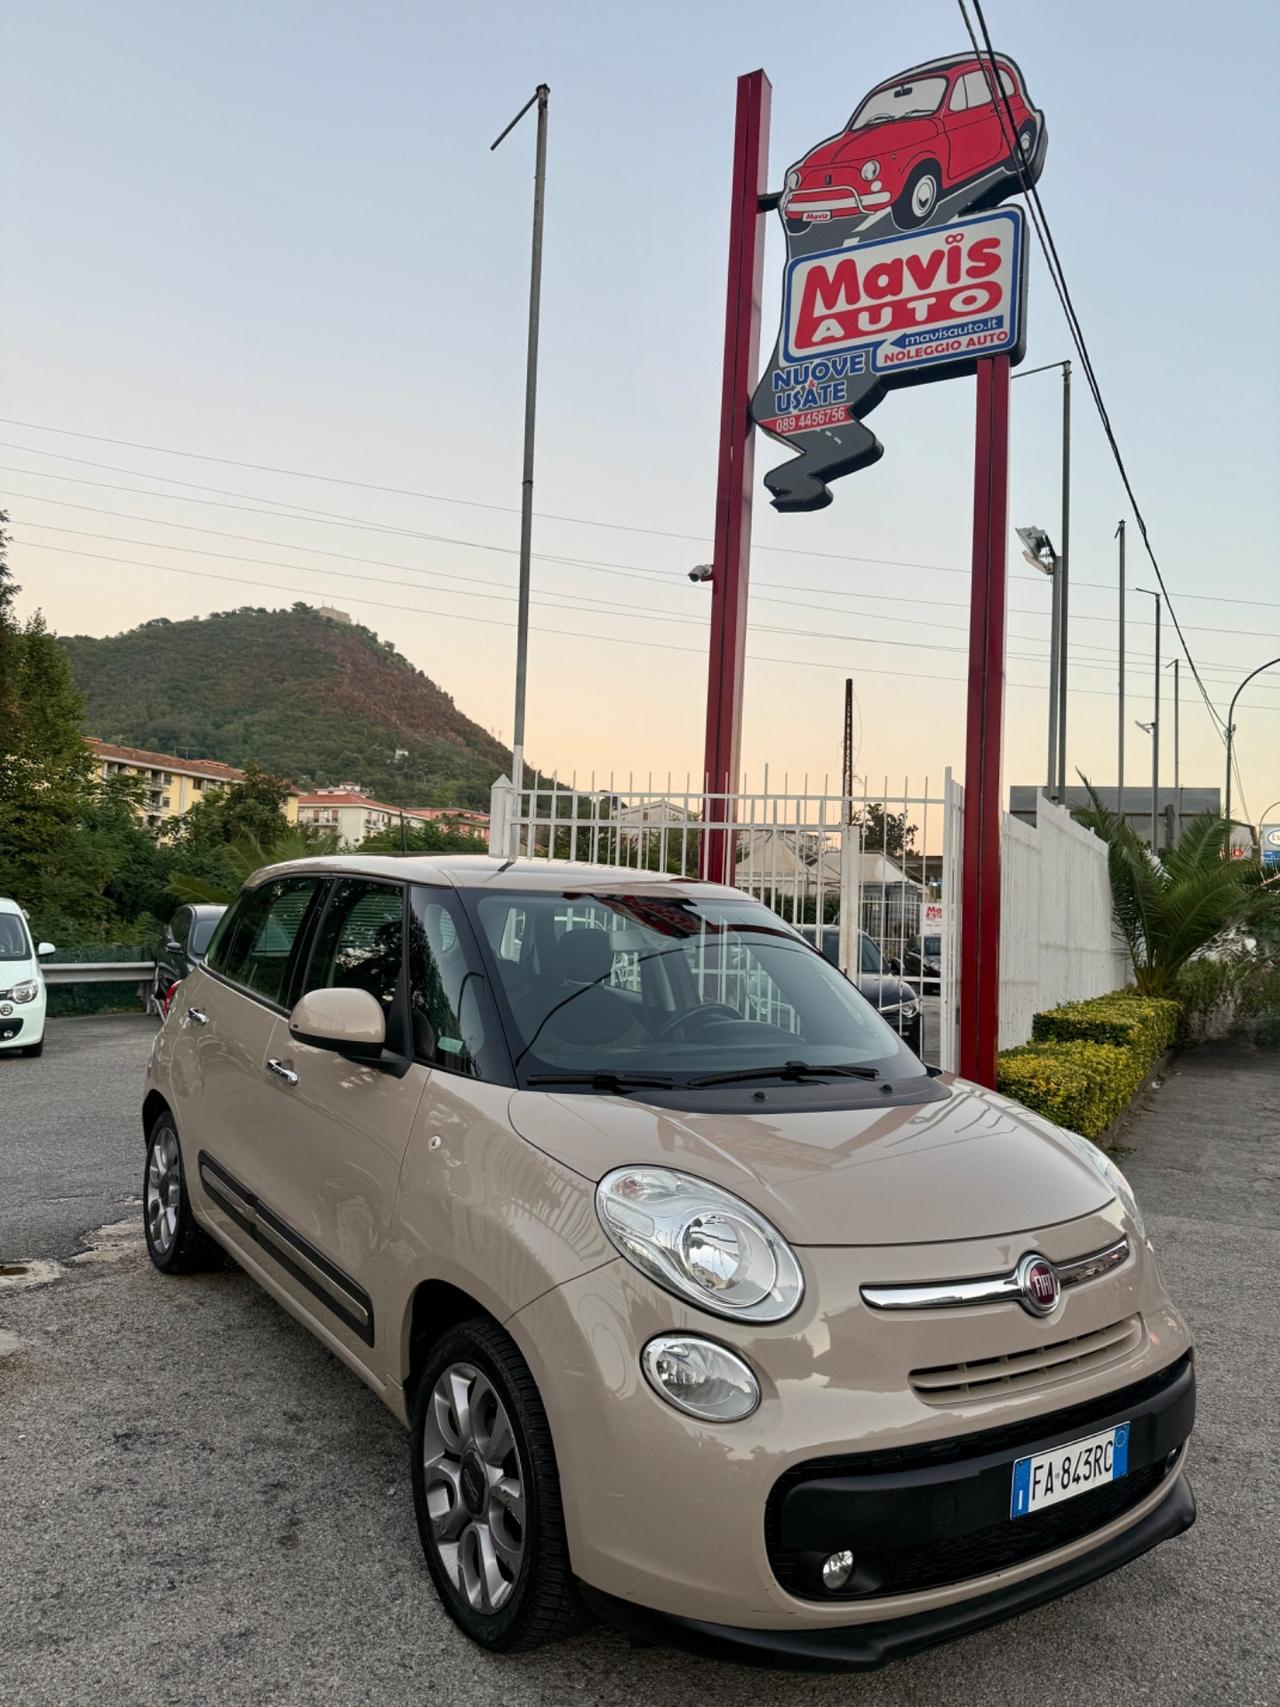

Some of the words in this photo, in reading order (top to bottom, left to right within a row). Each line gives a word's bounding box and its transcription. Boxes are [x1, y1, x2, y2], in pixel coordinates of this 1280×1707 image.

[811, 288, 991, 343] AUTO
[904, 316, 999, 344] mavisauto.it
[883, 340, 962, 364] NOLEGGIO
[966, 331, 1008, 348] AUTO
[773, 354, 864, 390] NUOVE
[775, 381, 848, 413] USATE
[776, 416, 796, 432] 089
[798, 407, 846, 428] 4456756
[1034, 1274, 1053, 1297] FIAT
